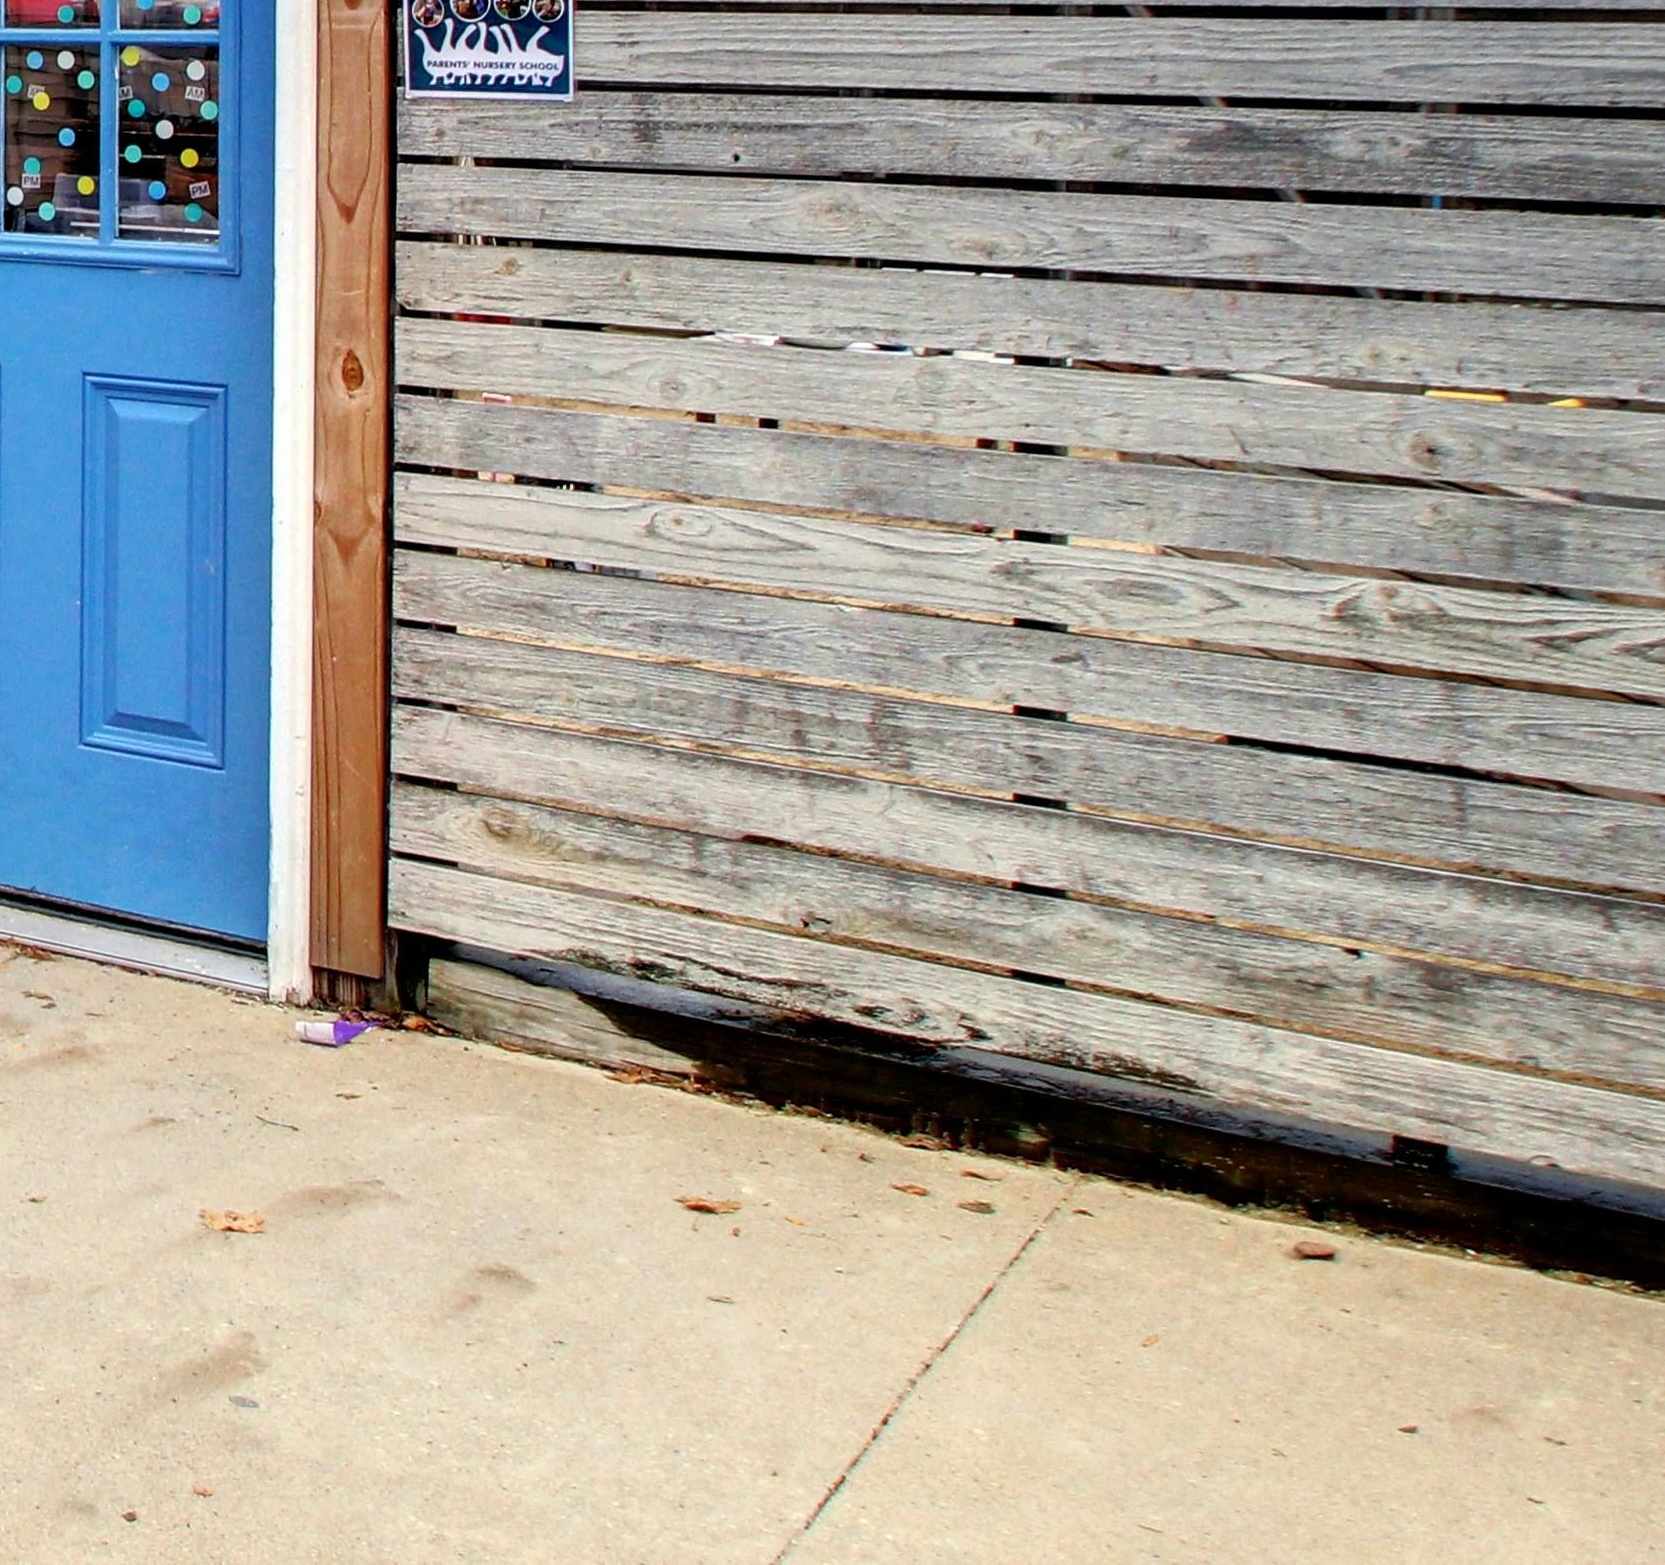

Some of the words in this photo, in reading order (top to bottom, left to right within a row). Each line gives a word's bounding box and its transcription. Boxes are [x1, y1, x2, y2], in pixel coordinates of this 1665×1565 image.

[473, 60, 516, 70] NURSERY
[519, 60, 559, 71] SCHOOL
[187, 87, 204, 100] AM
[23, 176, 40, 186] PM
[191, 185, 209, 197] PM
